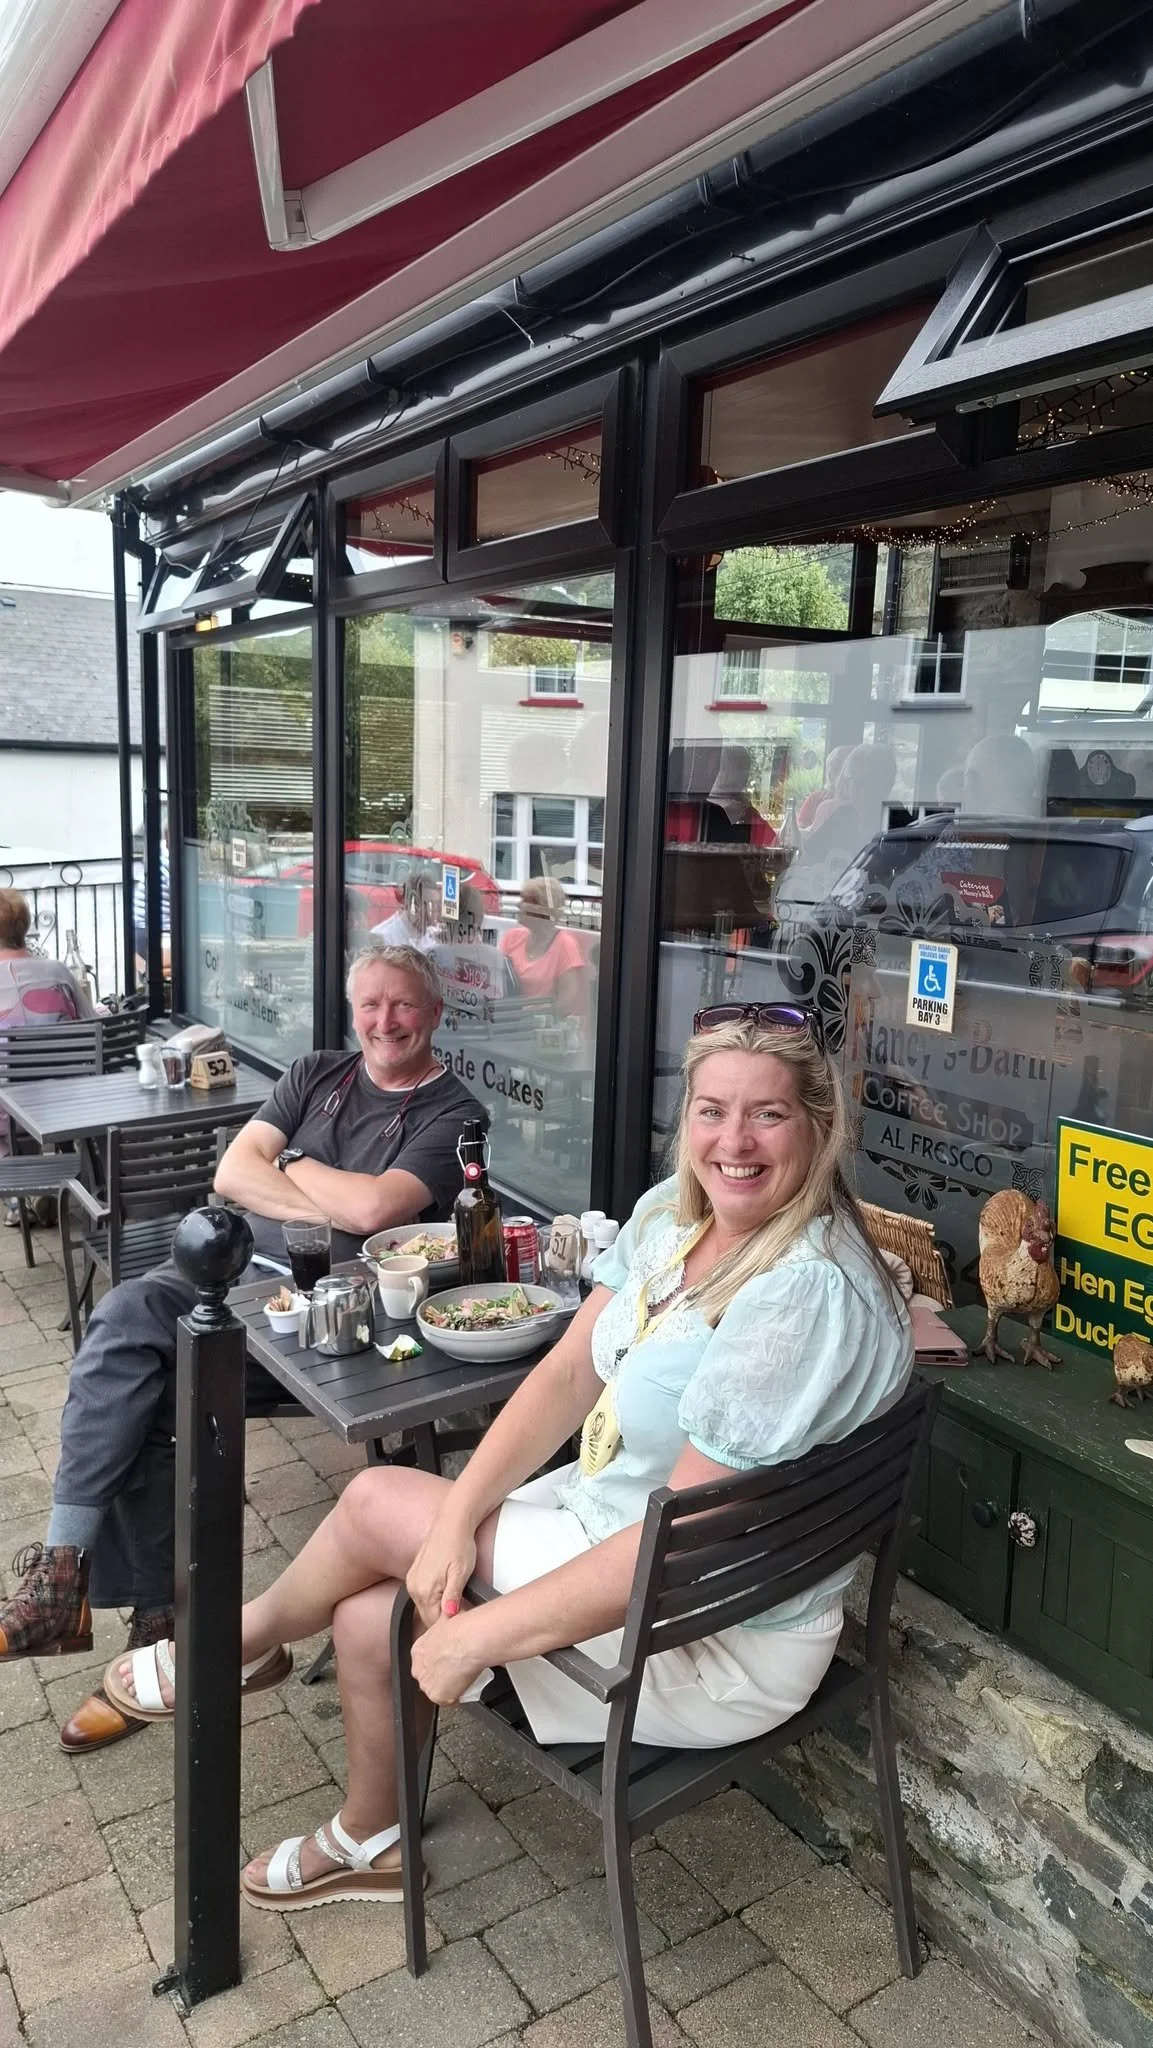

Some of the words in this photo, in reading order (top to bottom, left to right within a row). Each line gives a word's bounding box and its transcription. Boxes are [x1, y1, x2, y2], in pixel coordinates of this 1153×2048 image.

[959, 880, 990, 891] Catering
[912, 997, 948, 1015] PARKING
[917, 1011, 933, 1024] BAY
[935, 1014, 941, 1026] 3
[207, 1058, 231, 1077] 52
[482, 1060, 544, 1112] Cakes
[956, 1102, 1024, 1147] SHOP
[880, 1124, 905, 1151] AL
[911, 1132, 993, 1177] FRESCO
[1069, 1141, 1152, 1197] Free
[1060, 1256, 1116, 1304] Hen
